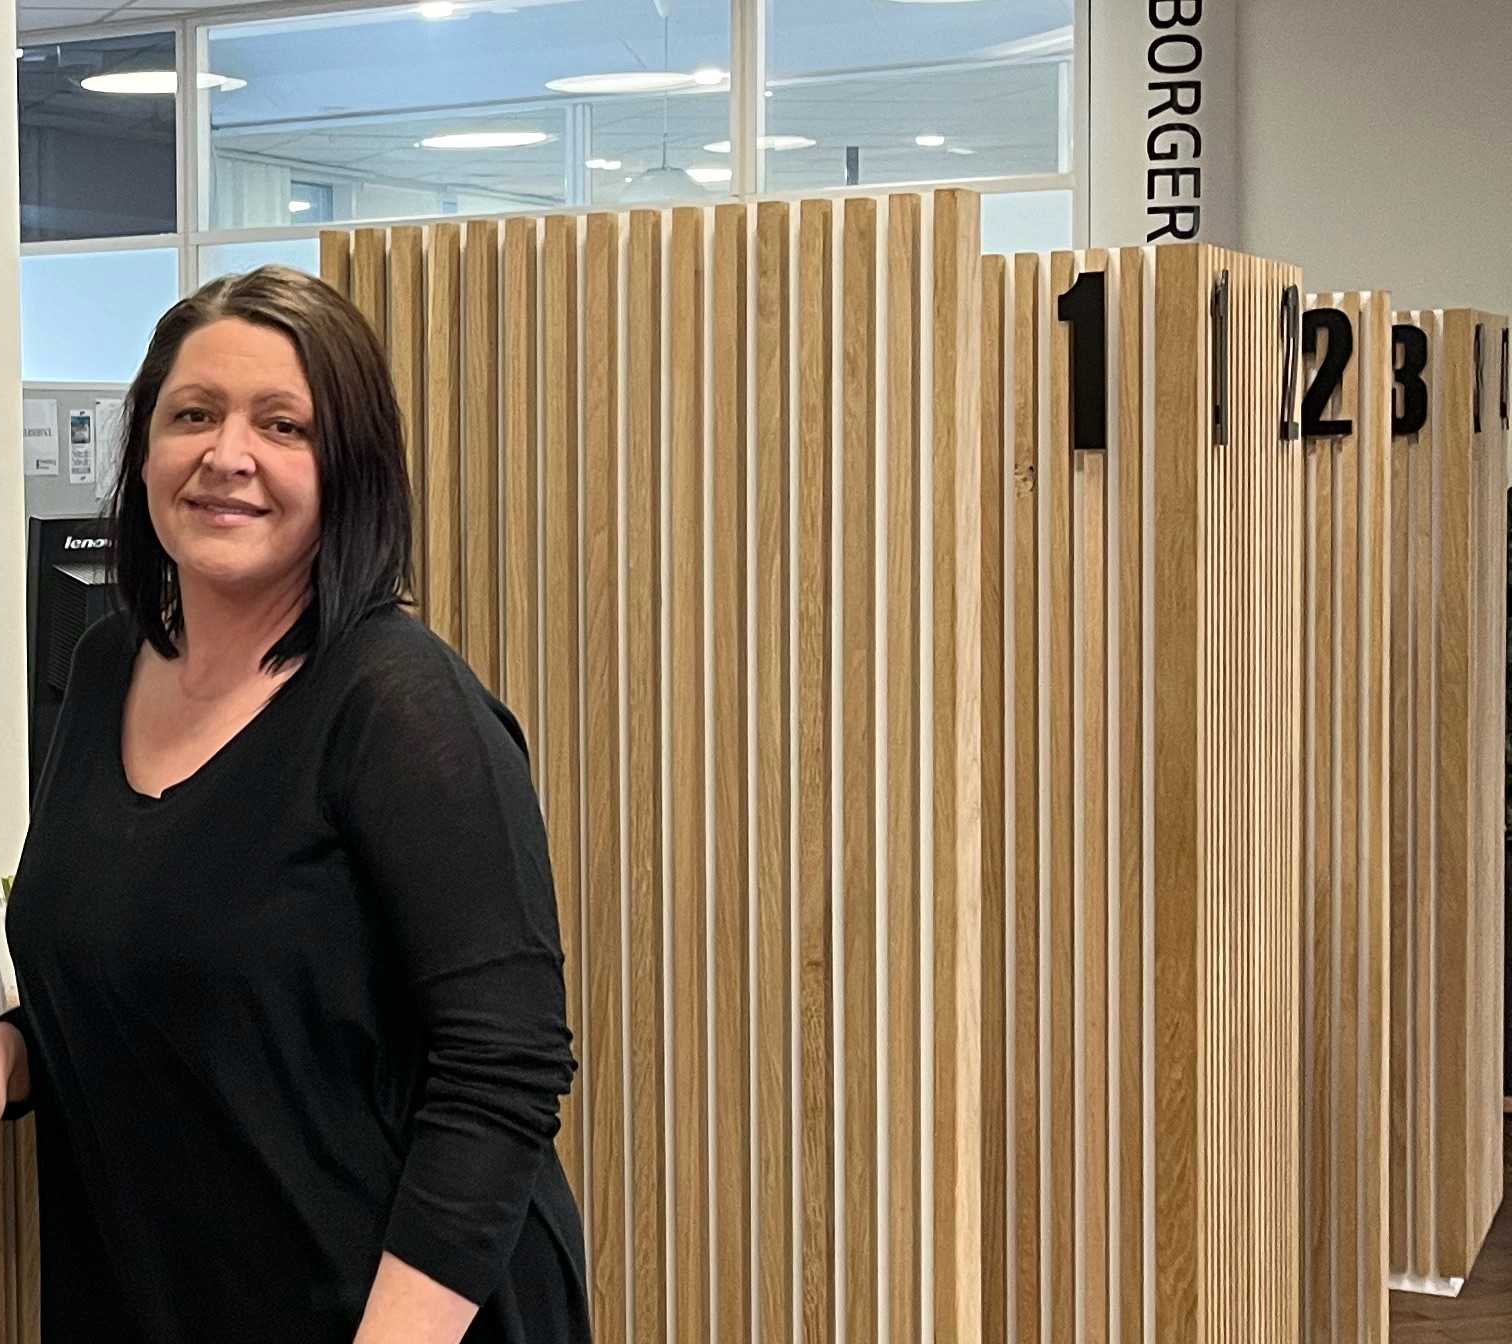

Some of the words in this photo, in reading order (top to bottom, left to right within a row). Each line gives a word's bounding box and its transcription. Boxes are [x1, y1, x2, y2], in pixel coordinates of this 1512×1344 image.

[1057, 270, 1107, 450] 1
[1301, 308, 1354, 436] 2
[1391, 324, 1428, 435] 3
